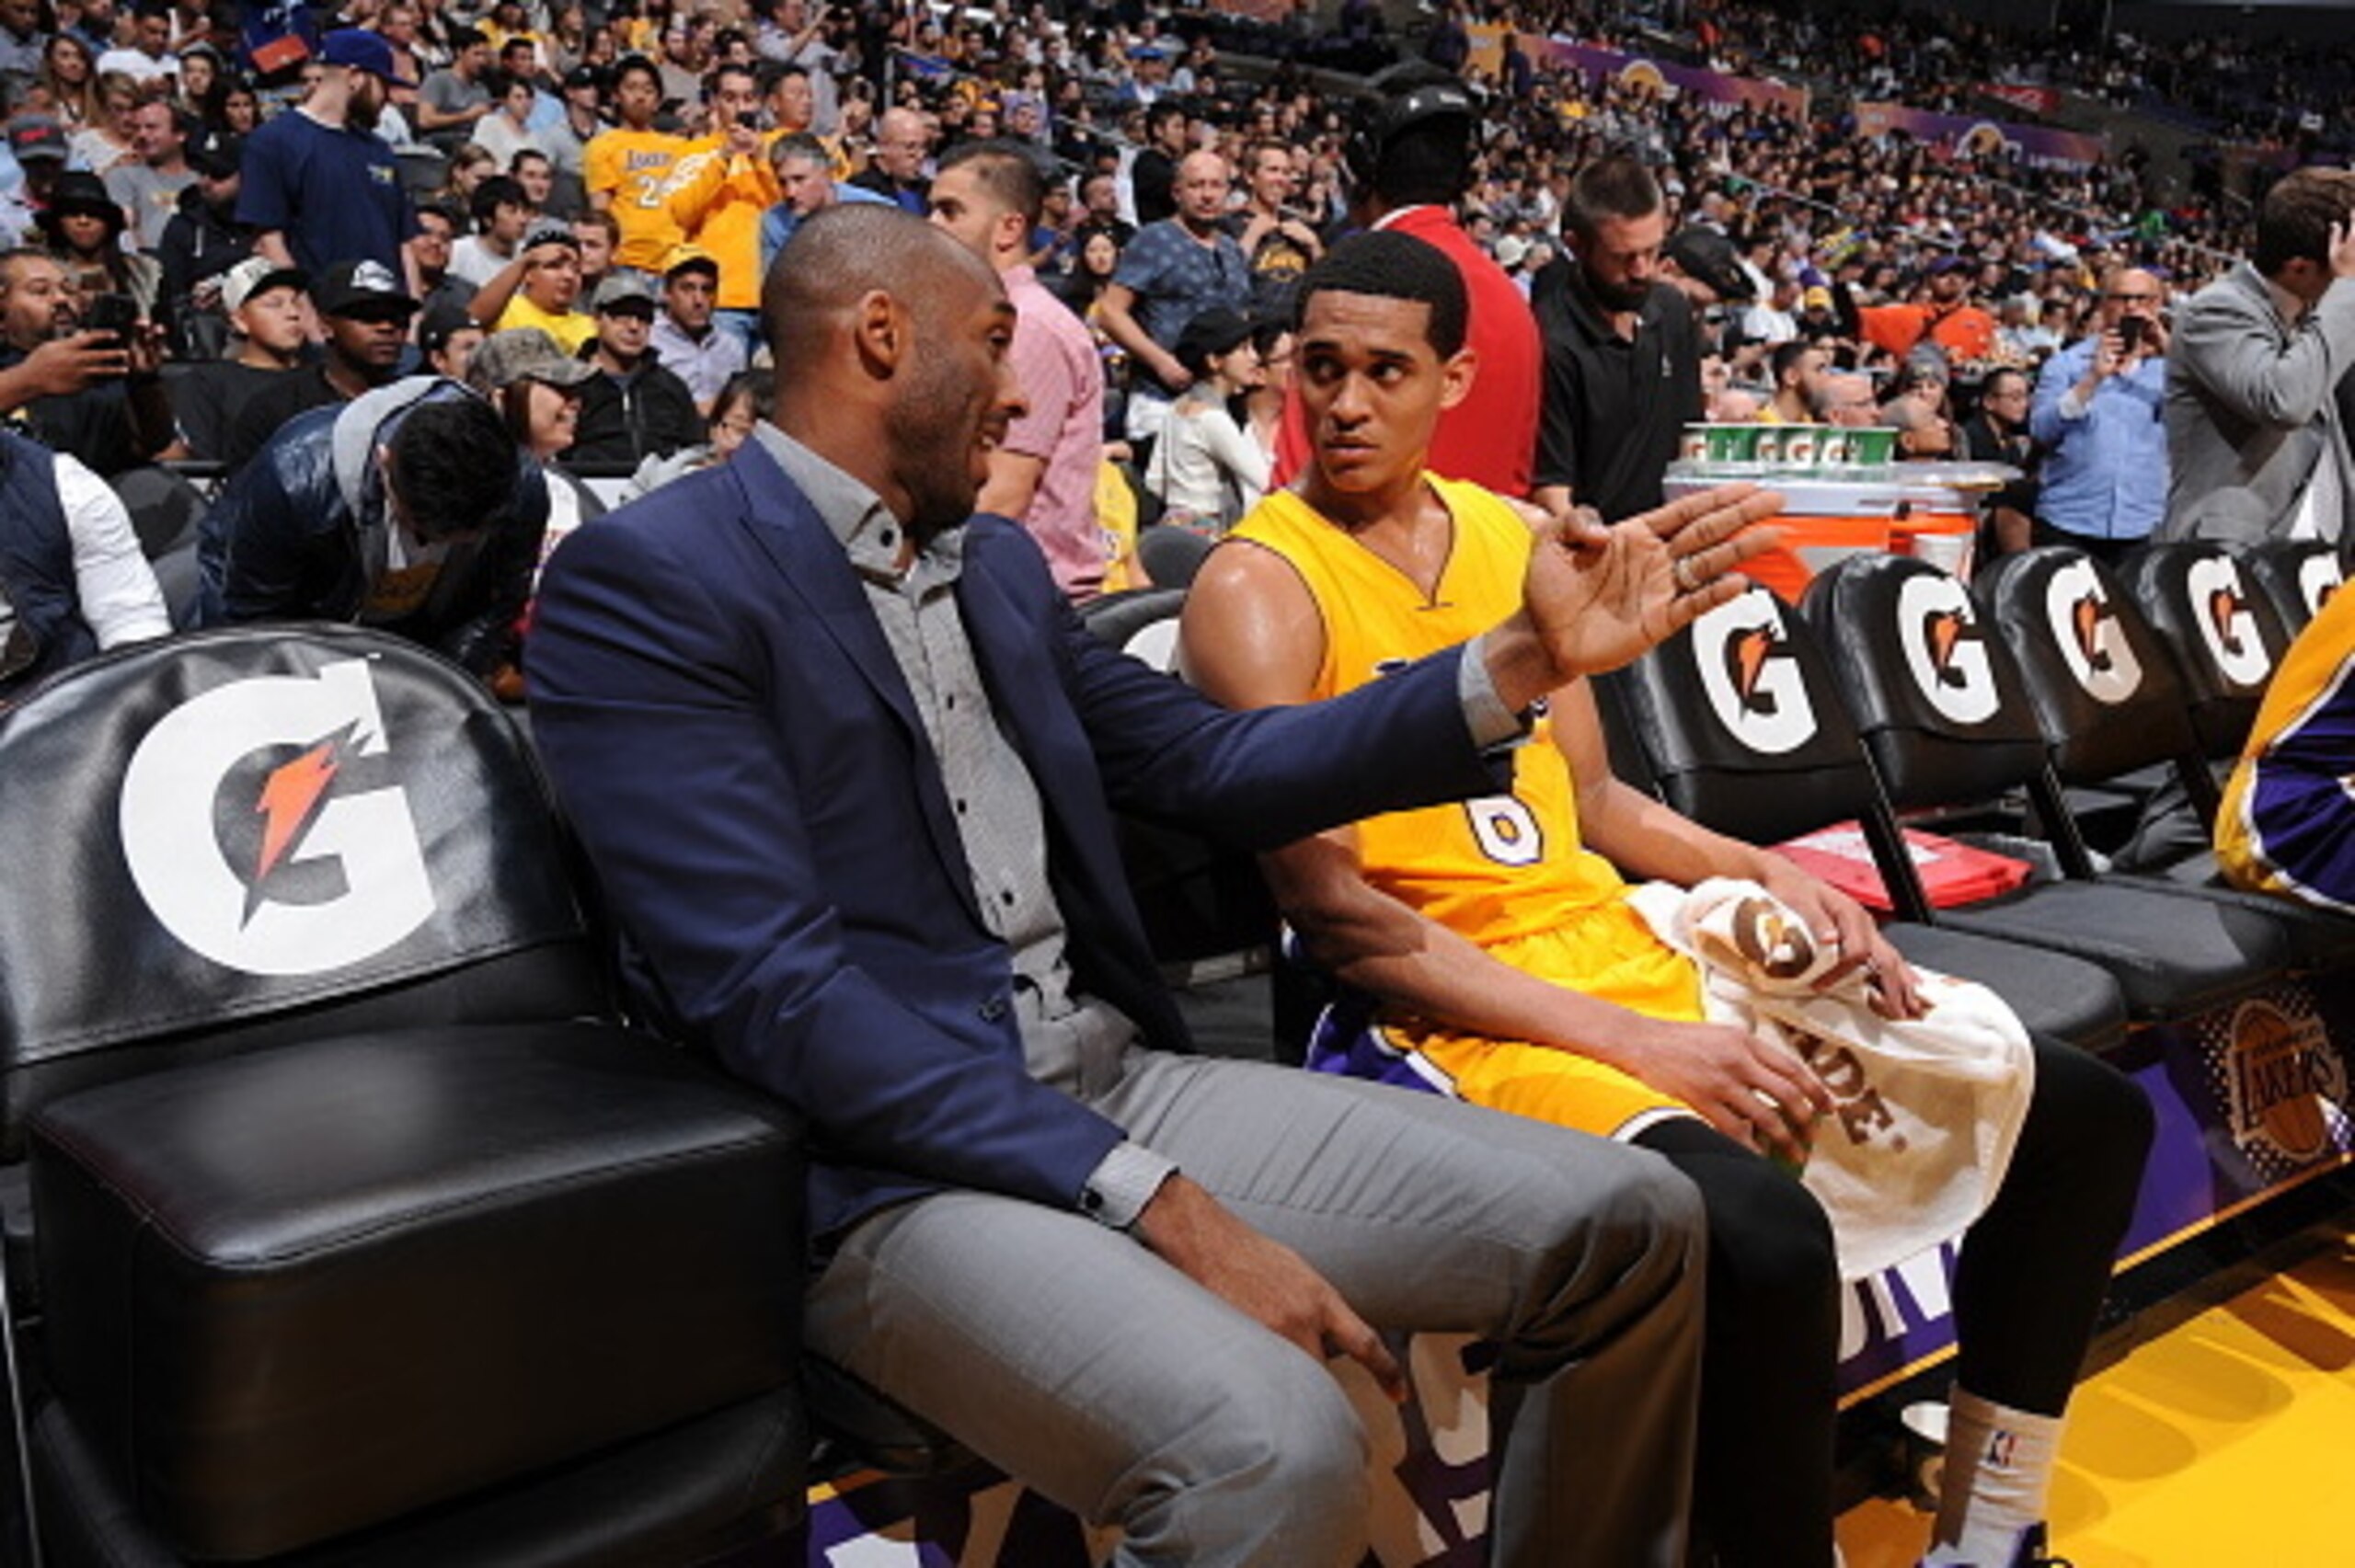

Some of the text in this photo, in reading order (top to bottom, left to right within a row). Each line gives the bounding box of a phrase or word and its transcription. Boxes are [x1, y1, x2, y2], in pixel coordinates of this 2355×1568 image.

[1691, 587, 1818, 753] G
[1898, 566, 2001, 724] G
[2047, 556, 2142, 703] G
[2188, 555, 2271, 685] G
[120, 658, 437, 976] G
[1732, 896, 1815, 979] G
